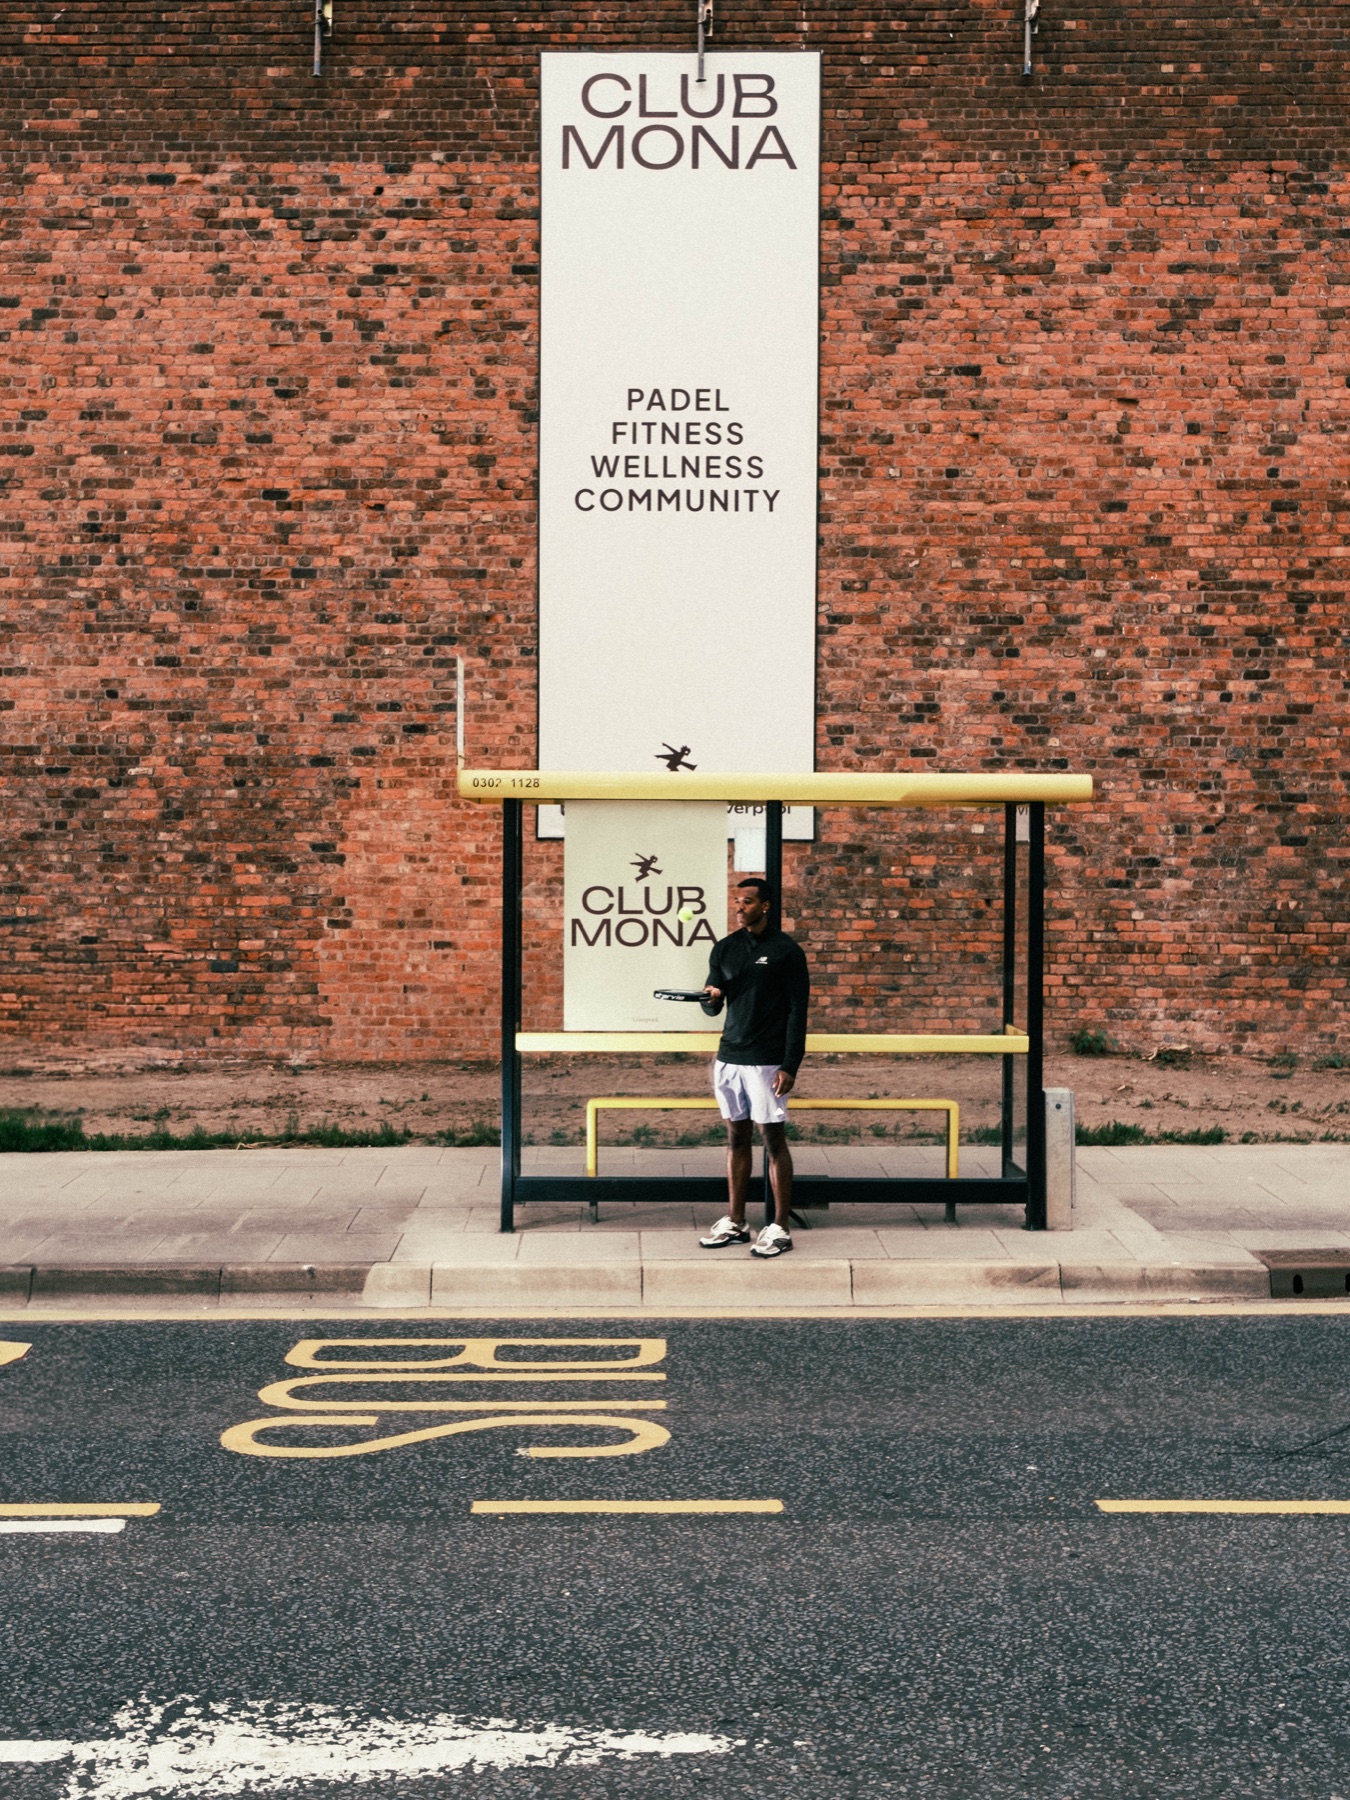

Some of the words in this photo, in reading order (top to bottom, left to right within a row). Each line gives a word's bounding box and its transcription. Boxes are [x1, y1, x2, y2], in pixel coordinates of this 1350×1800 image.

[581, 73, 778, 118] CLUB
[561, 124, 798, 170] MONA
[627, 388, 730, 411] PADEL
[612, 422, 744, 445] FITNESS
[590, 455, 764, 478] WELLNESS
[574, 488, 780, 512] COMMUNITY
[511, 778, 540, 788] 1128
[581, 886, 707, 915] CLUB
[571, 918, 718, 947] MONA
[219, 1338, 671, 1459] BUS
